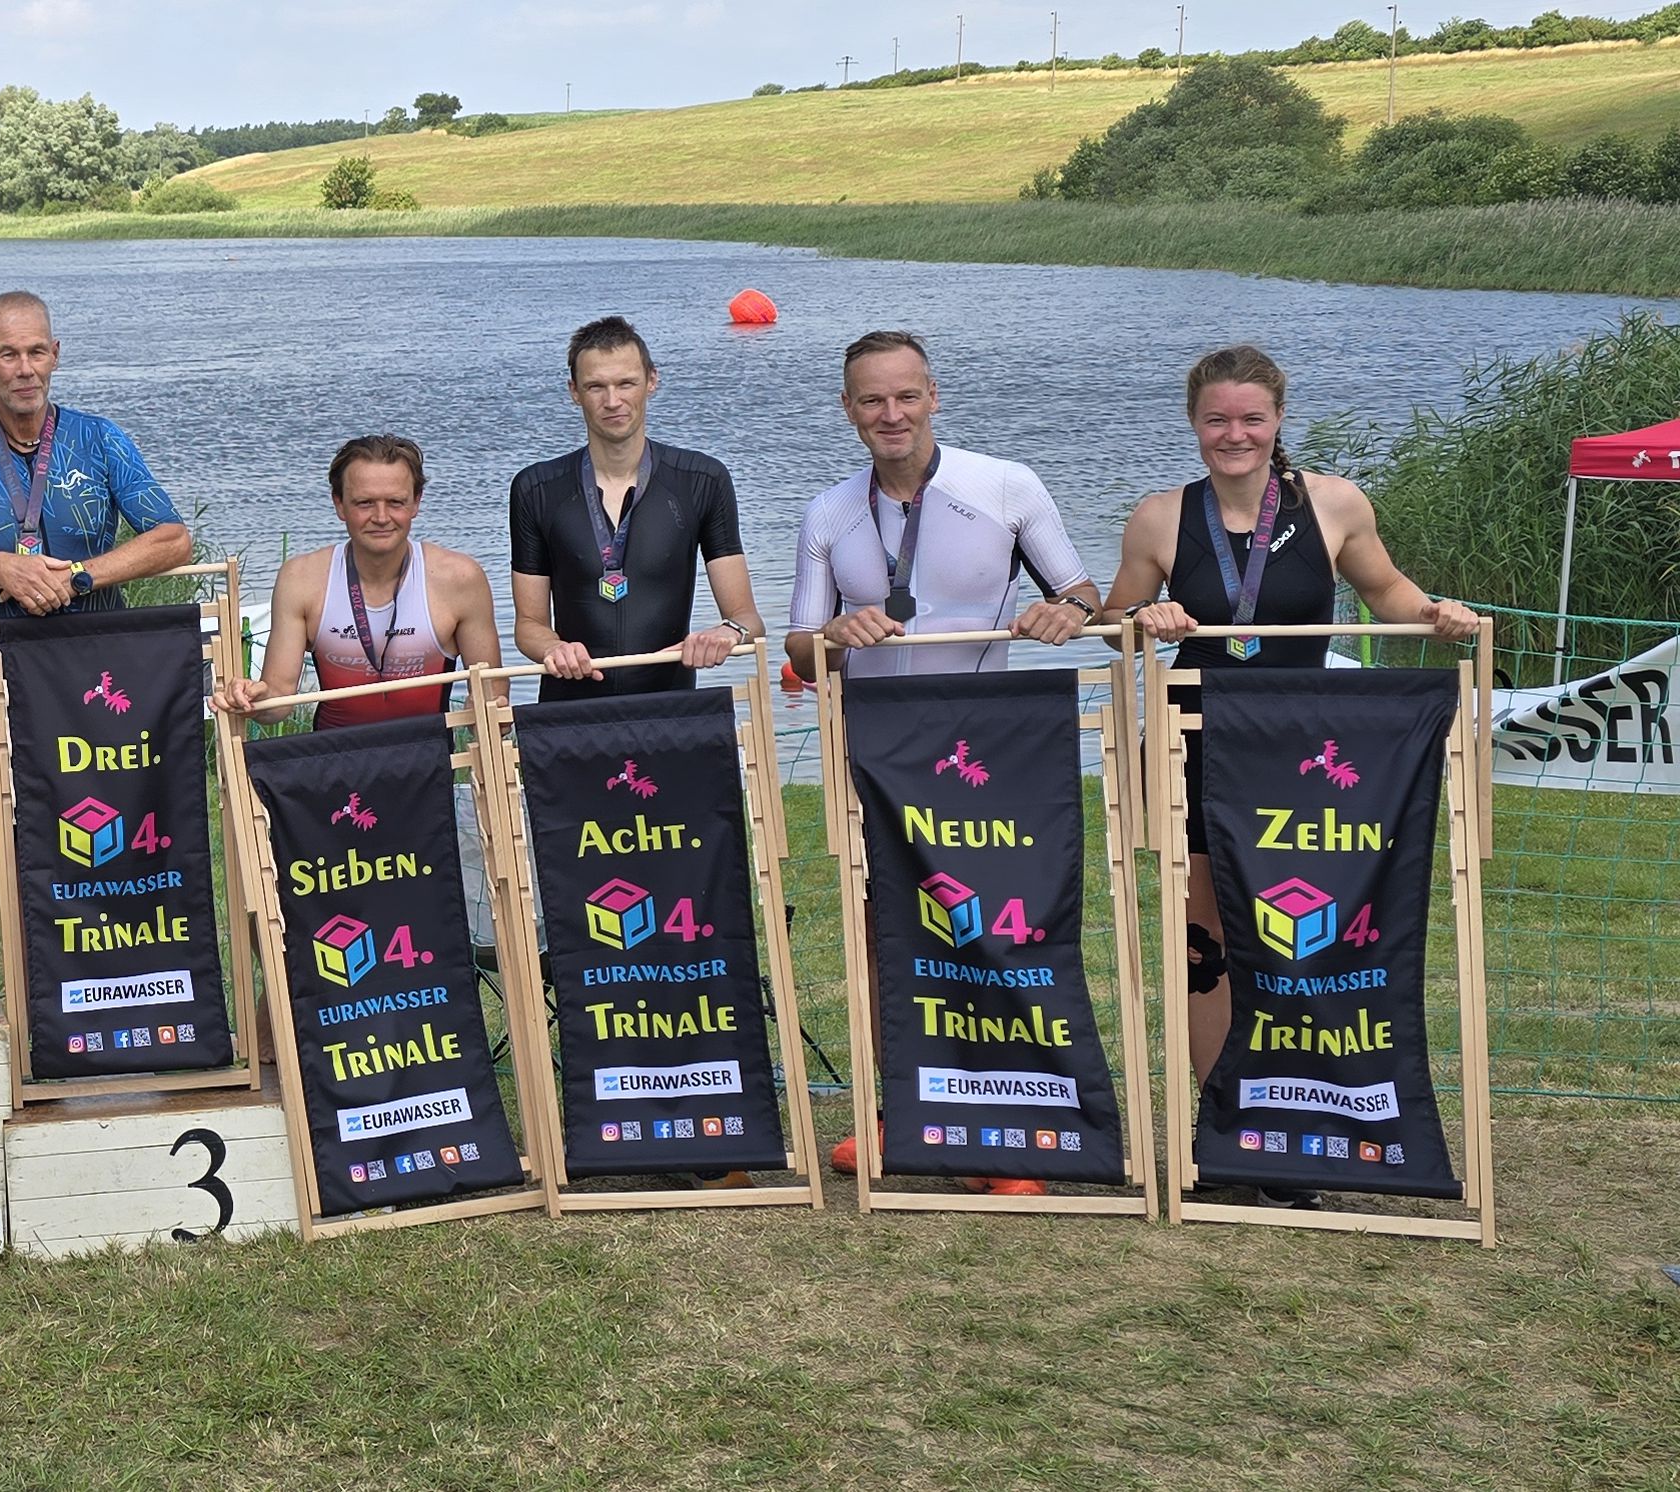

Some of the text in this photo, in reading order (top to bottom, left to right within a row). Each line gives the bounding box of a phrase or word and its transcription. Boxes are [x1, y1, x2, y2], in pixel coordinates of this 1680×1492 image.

[1266, 478, 1280, 506] 2026
[1270, 523, 1296, 553] 2XU
[131, 812, 172, 854] 4.
[52, 870, 183, 901] EURAWASSER
[663, 898, 714, 943] 4.
[991, 898, 1046, 945] 4.
[1343, 903, 1380, 948] 4.
[383, 925, 434, 968] 4.
[583, 959, 728, 987] EURAWASSER
[914, 957, 1055, 989] EURAWASSER
[1254, 967, 1387, 997] EURAWASSER
[83, 978, 186, 1003] EURAWASSER
[318, 986, 449, 1026] EURAWASSER
[619, 1069, 733, 1092] EURAWASSER
[947, 1076, 1071, 1101] EURAWASSER
[1268, 1083, 1390, 1114] EURAWASSER
[362, 1098, 463, 1131] EURAWASSER
[169, 1127, 235, 1244] 3
